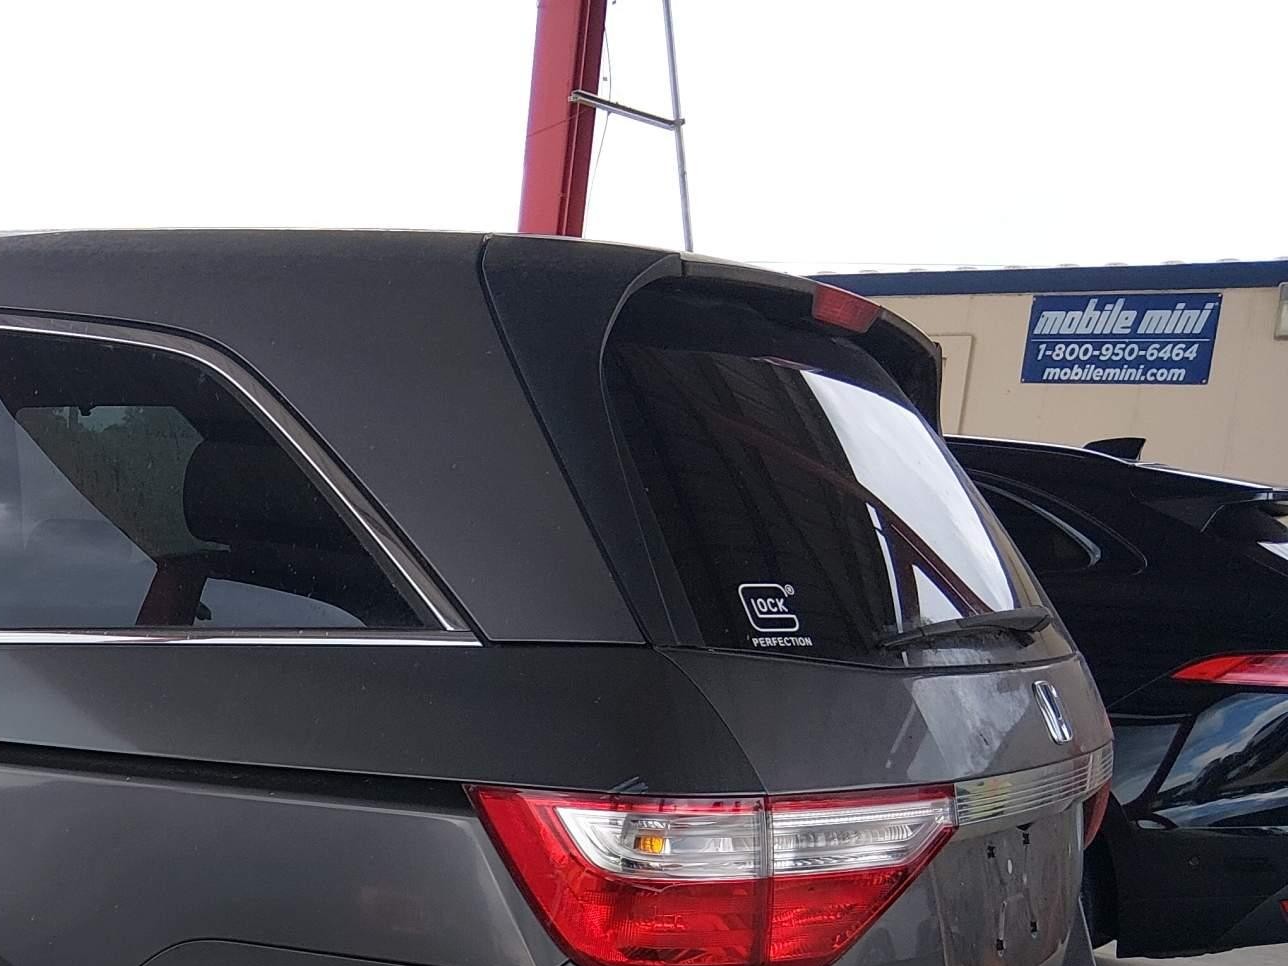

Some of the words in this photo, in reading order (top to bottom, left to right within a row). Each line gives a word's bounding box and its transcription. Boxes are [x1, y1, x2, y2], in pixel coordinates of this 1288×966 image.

[1033, 298, 1137, 335] mobile
[1137, 302, 1214, 334] mini
[1037, 343, 1198, 361] 1-800-950-6464
[1042, 364, 1186, 382] mobilemini.com
[751, 636, 813, 648] PERFECTION
